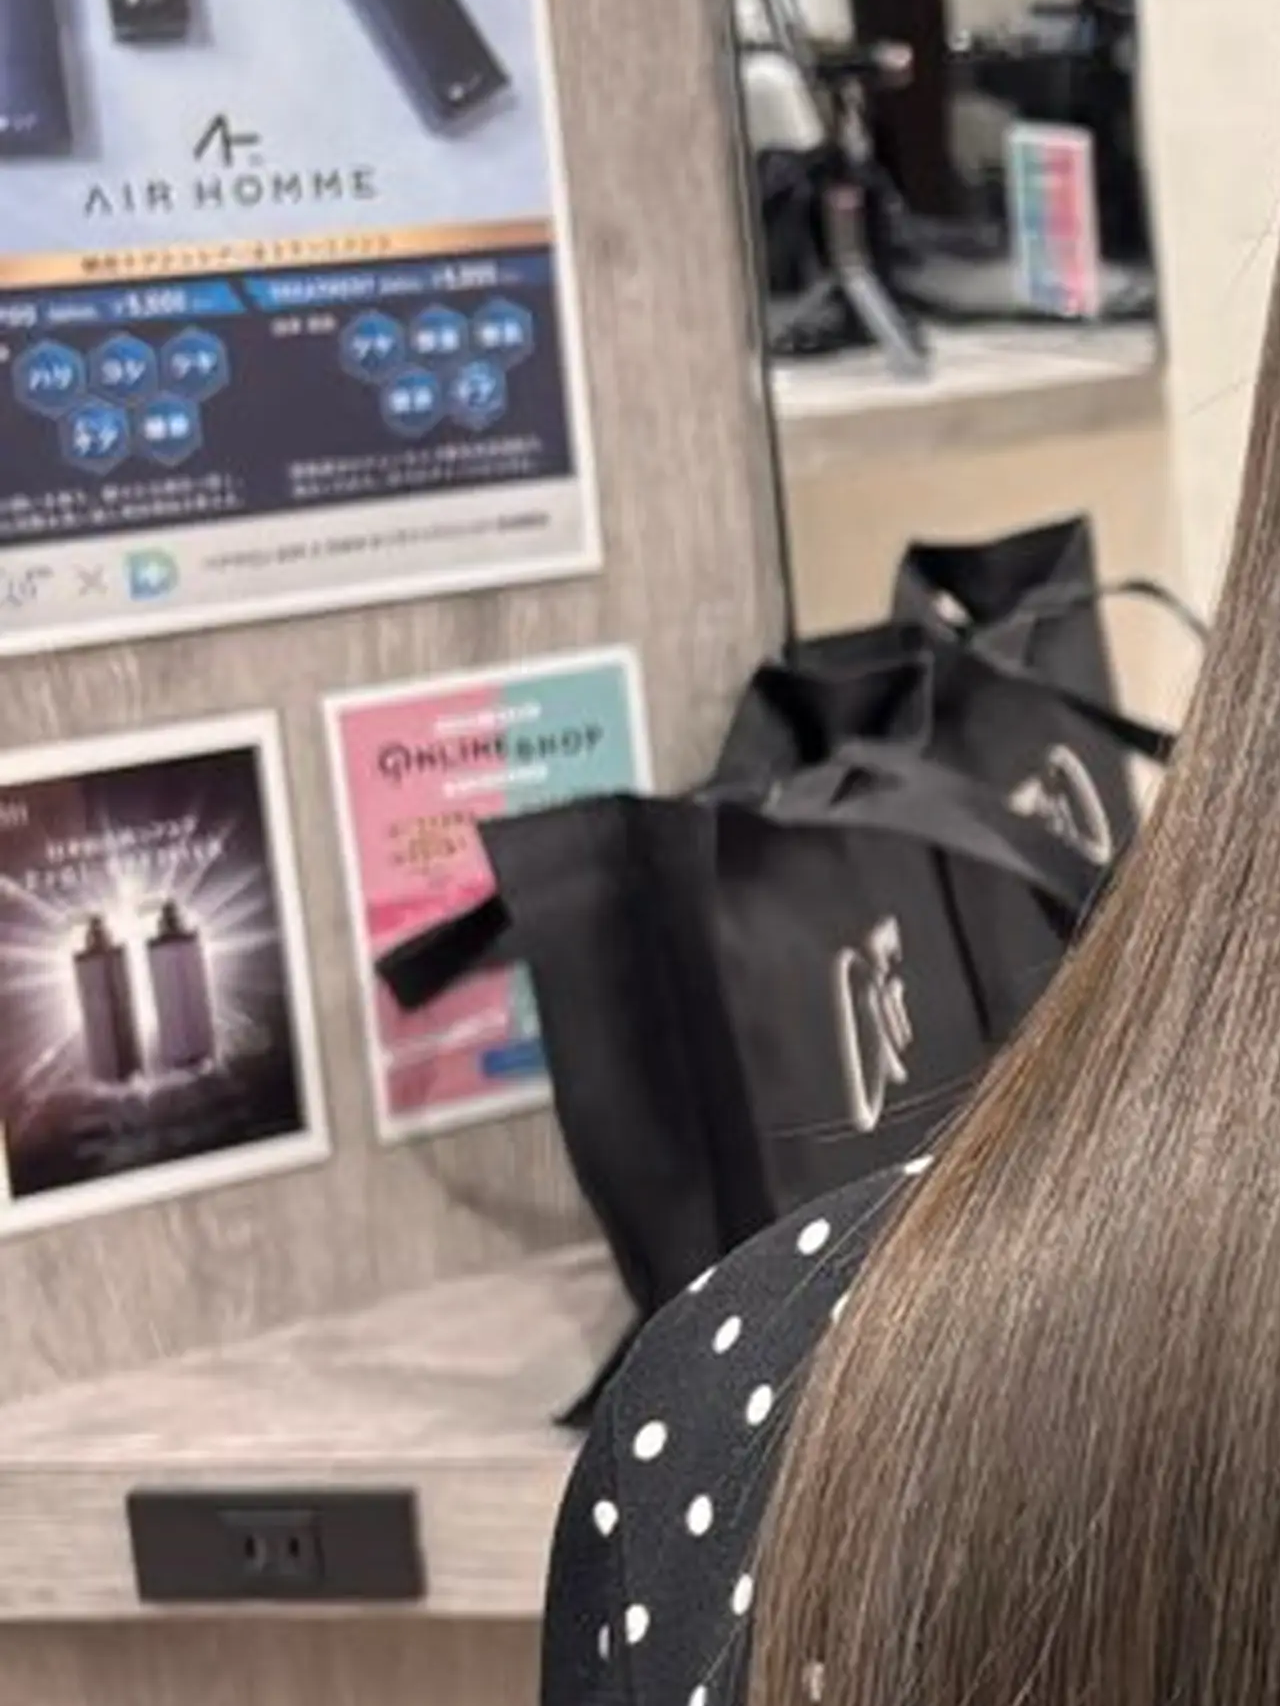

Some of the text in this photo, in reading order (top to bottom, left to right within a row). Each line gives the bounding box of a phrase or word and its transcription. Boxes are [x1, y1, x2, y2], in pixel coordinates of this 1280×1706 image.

[84, 165, 378, 217] AIR HOMME
[378, 733, 507, 782] ONLINE
